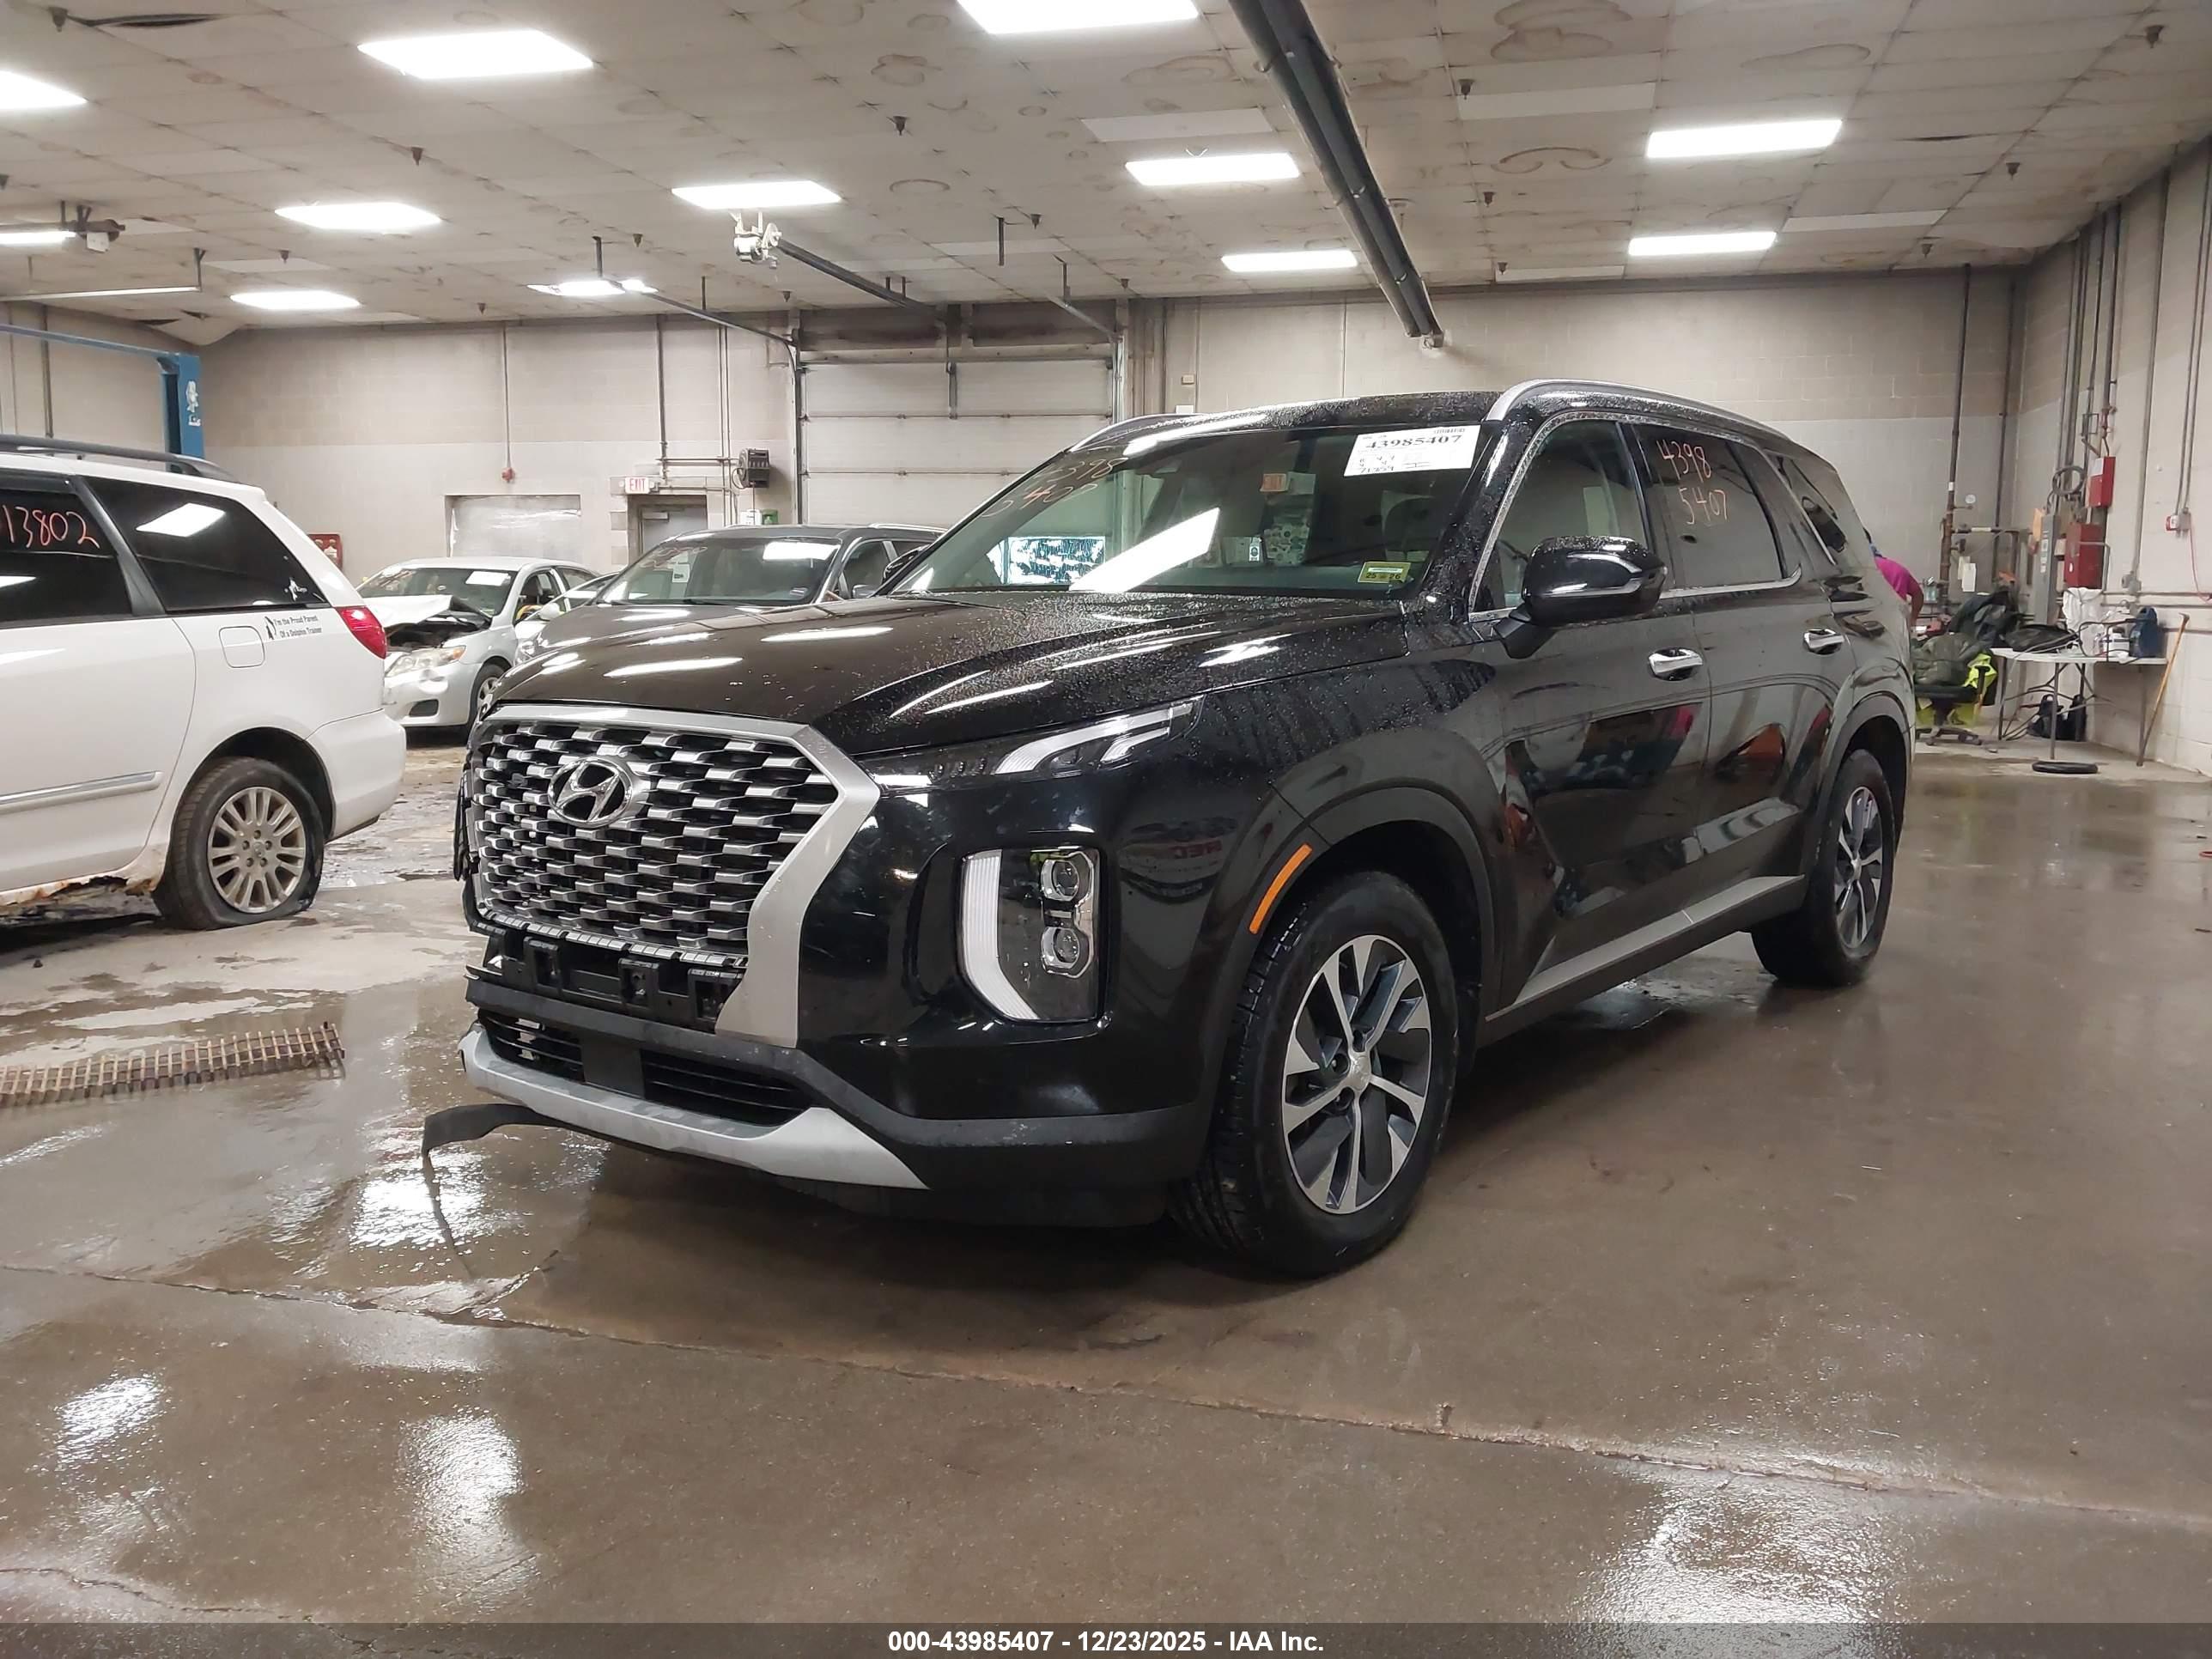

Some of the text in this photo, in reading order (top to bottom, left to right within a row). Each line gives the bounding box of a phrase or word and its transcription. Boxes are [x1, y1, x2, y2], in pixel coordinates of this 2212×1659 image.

[1365, 434, 1463, 449] 43985407
[1655, 439, 1711, 483] 4398
[629, 477, 646, 492] EXIT
[1678, 487, 1728, 525] 5407
[2, 504, 100, 548] 13802
[289, 615, 304, 624] Proud
[303, 614, 319, 623] Parent
